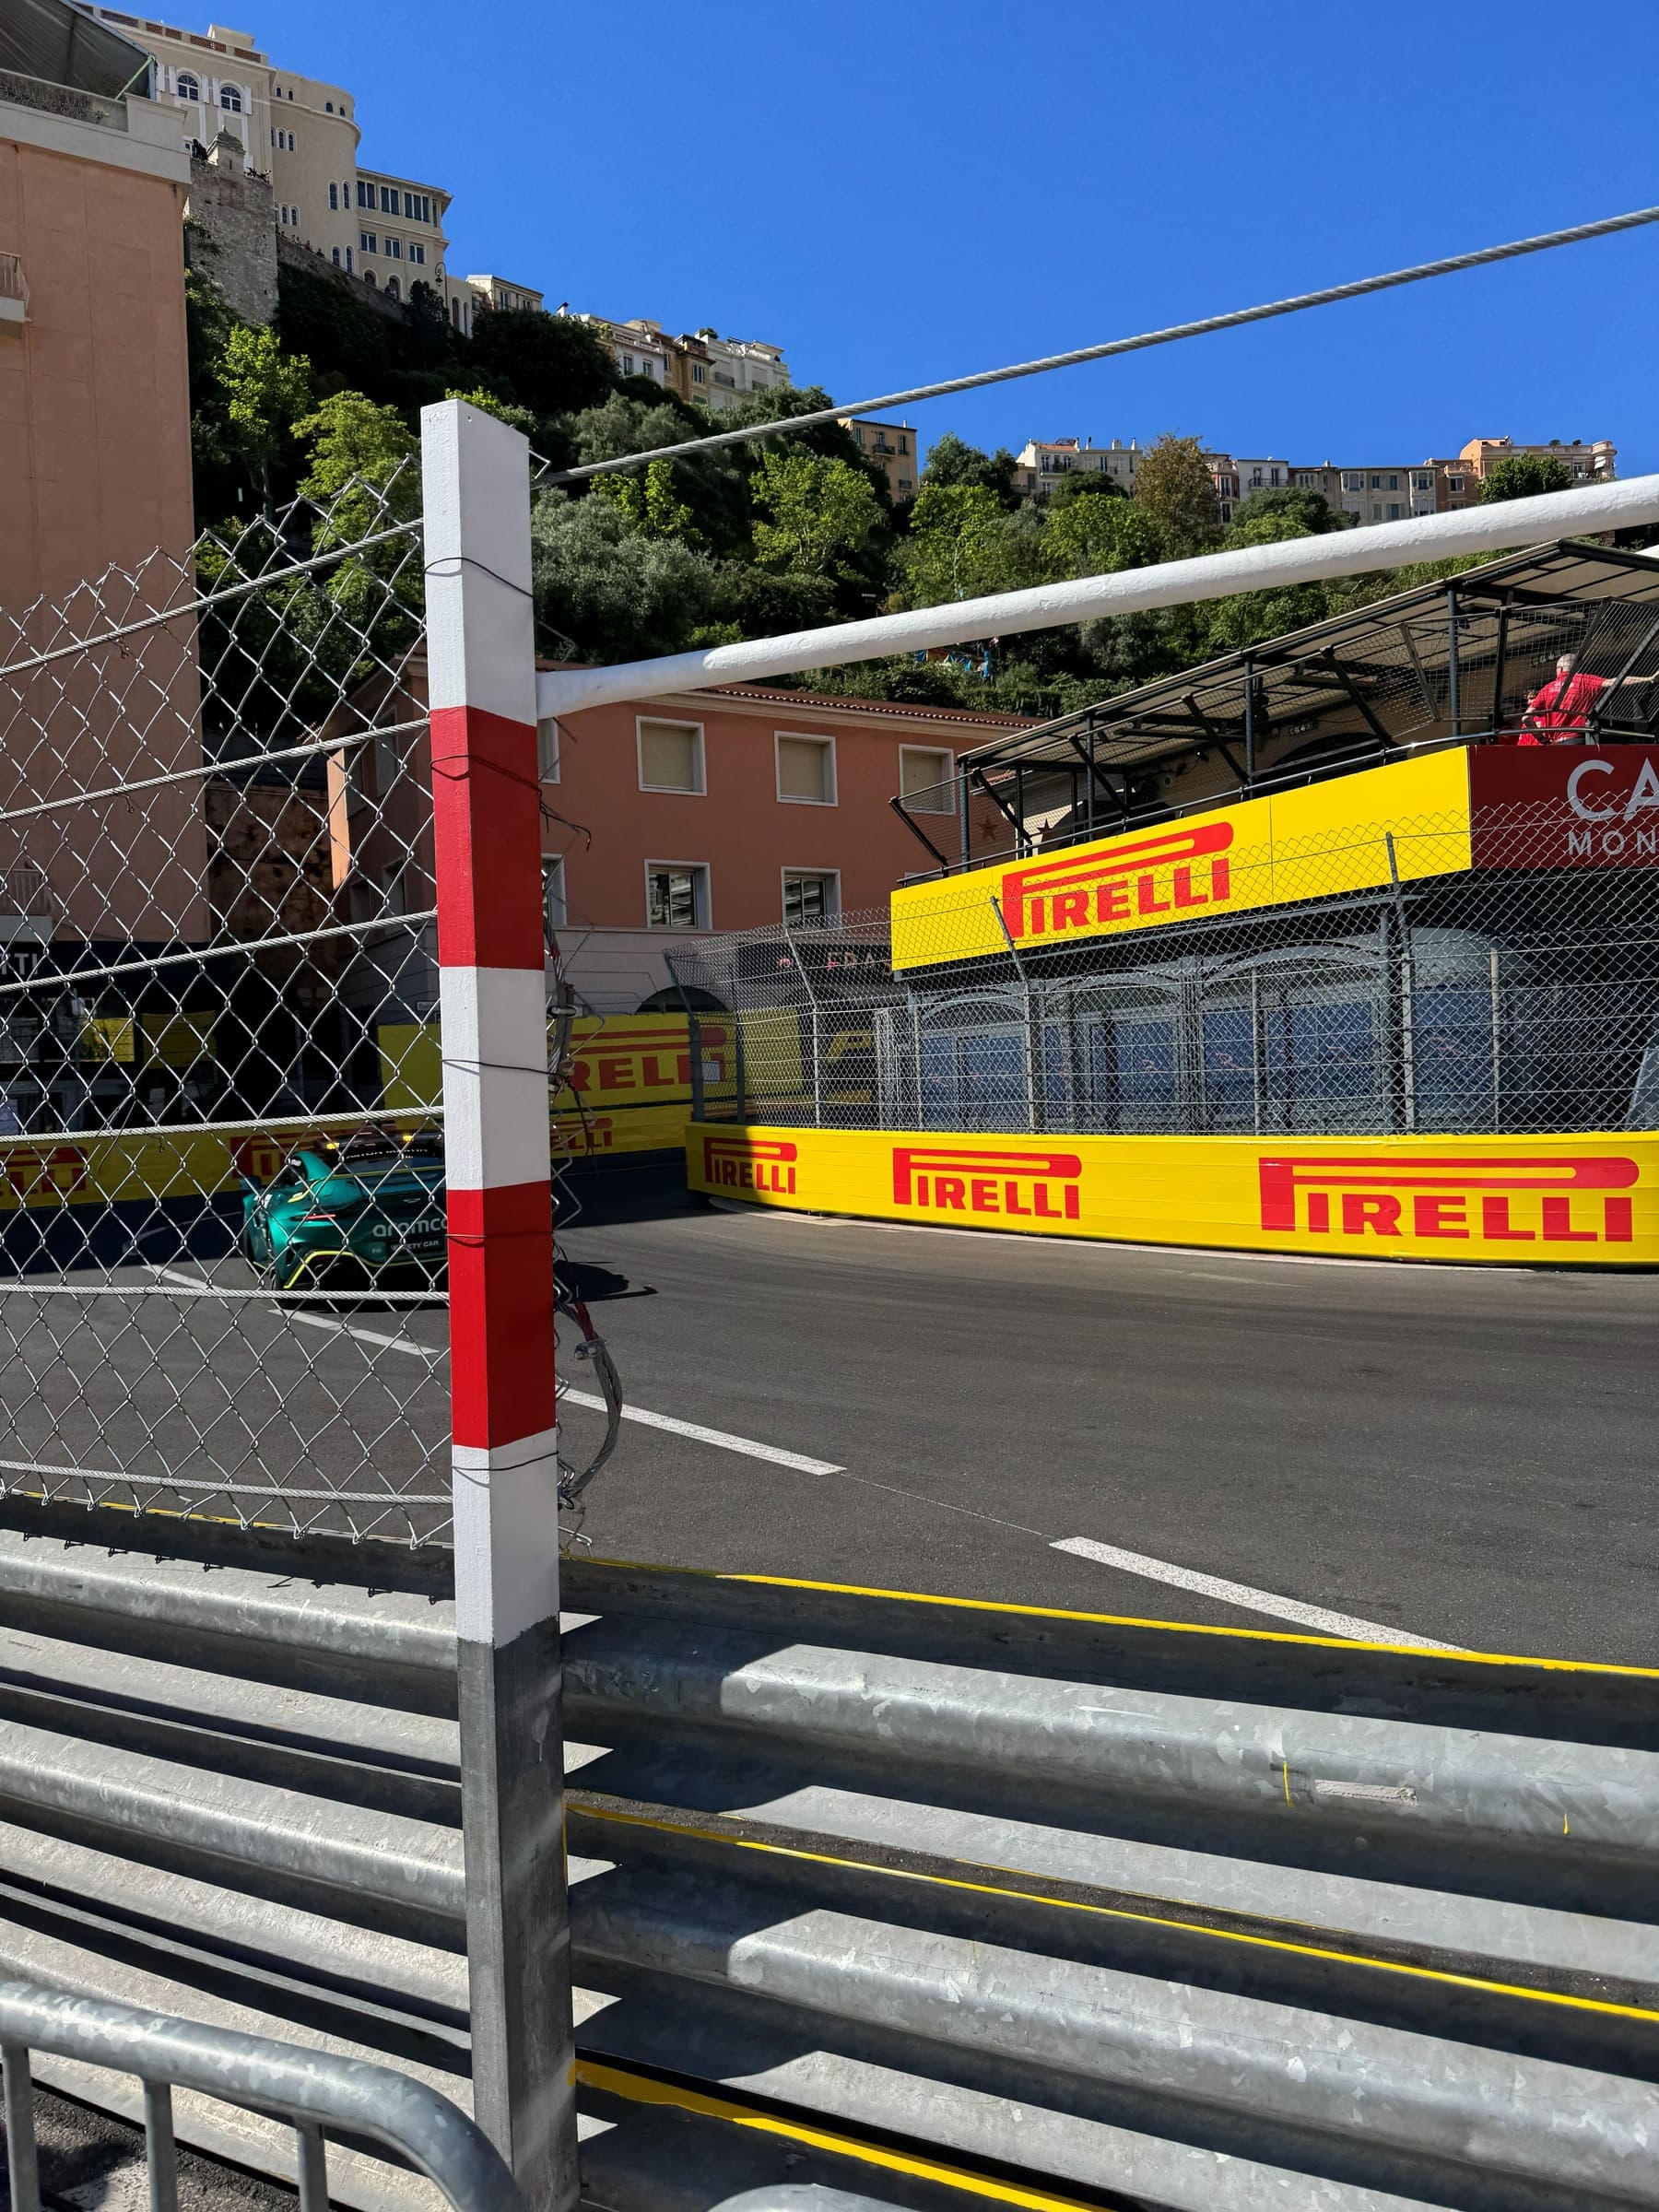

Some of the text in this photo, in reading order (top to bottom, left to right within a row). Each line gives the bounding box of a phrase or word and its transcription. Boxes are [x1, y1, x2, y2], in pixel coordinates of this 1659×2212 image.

[1002, 821, 1234, 939] PIRELLI
[703, 1136, 797, 1194] PIRELLI
[893, 1147, 1082, 1219] PIRELLI
[1259, 1158, 1640, 1242] PIRELLI
